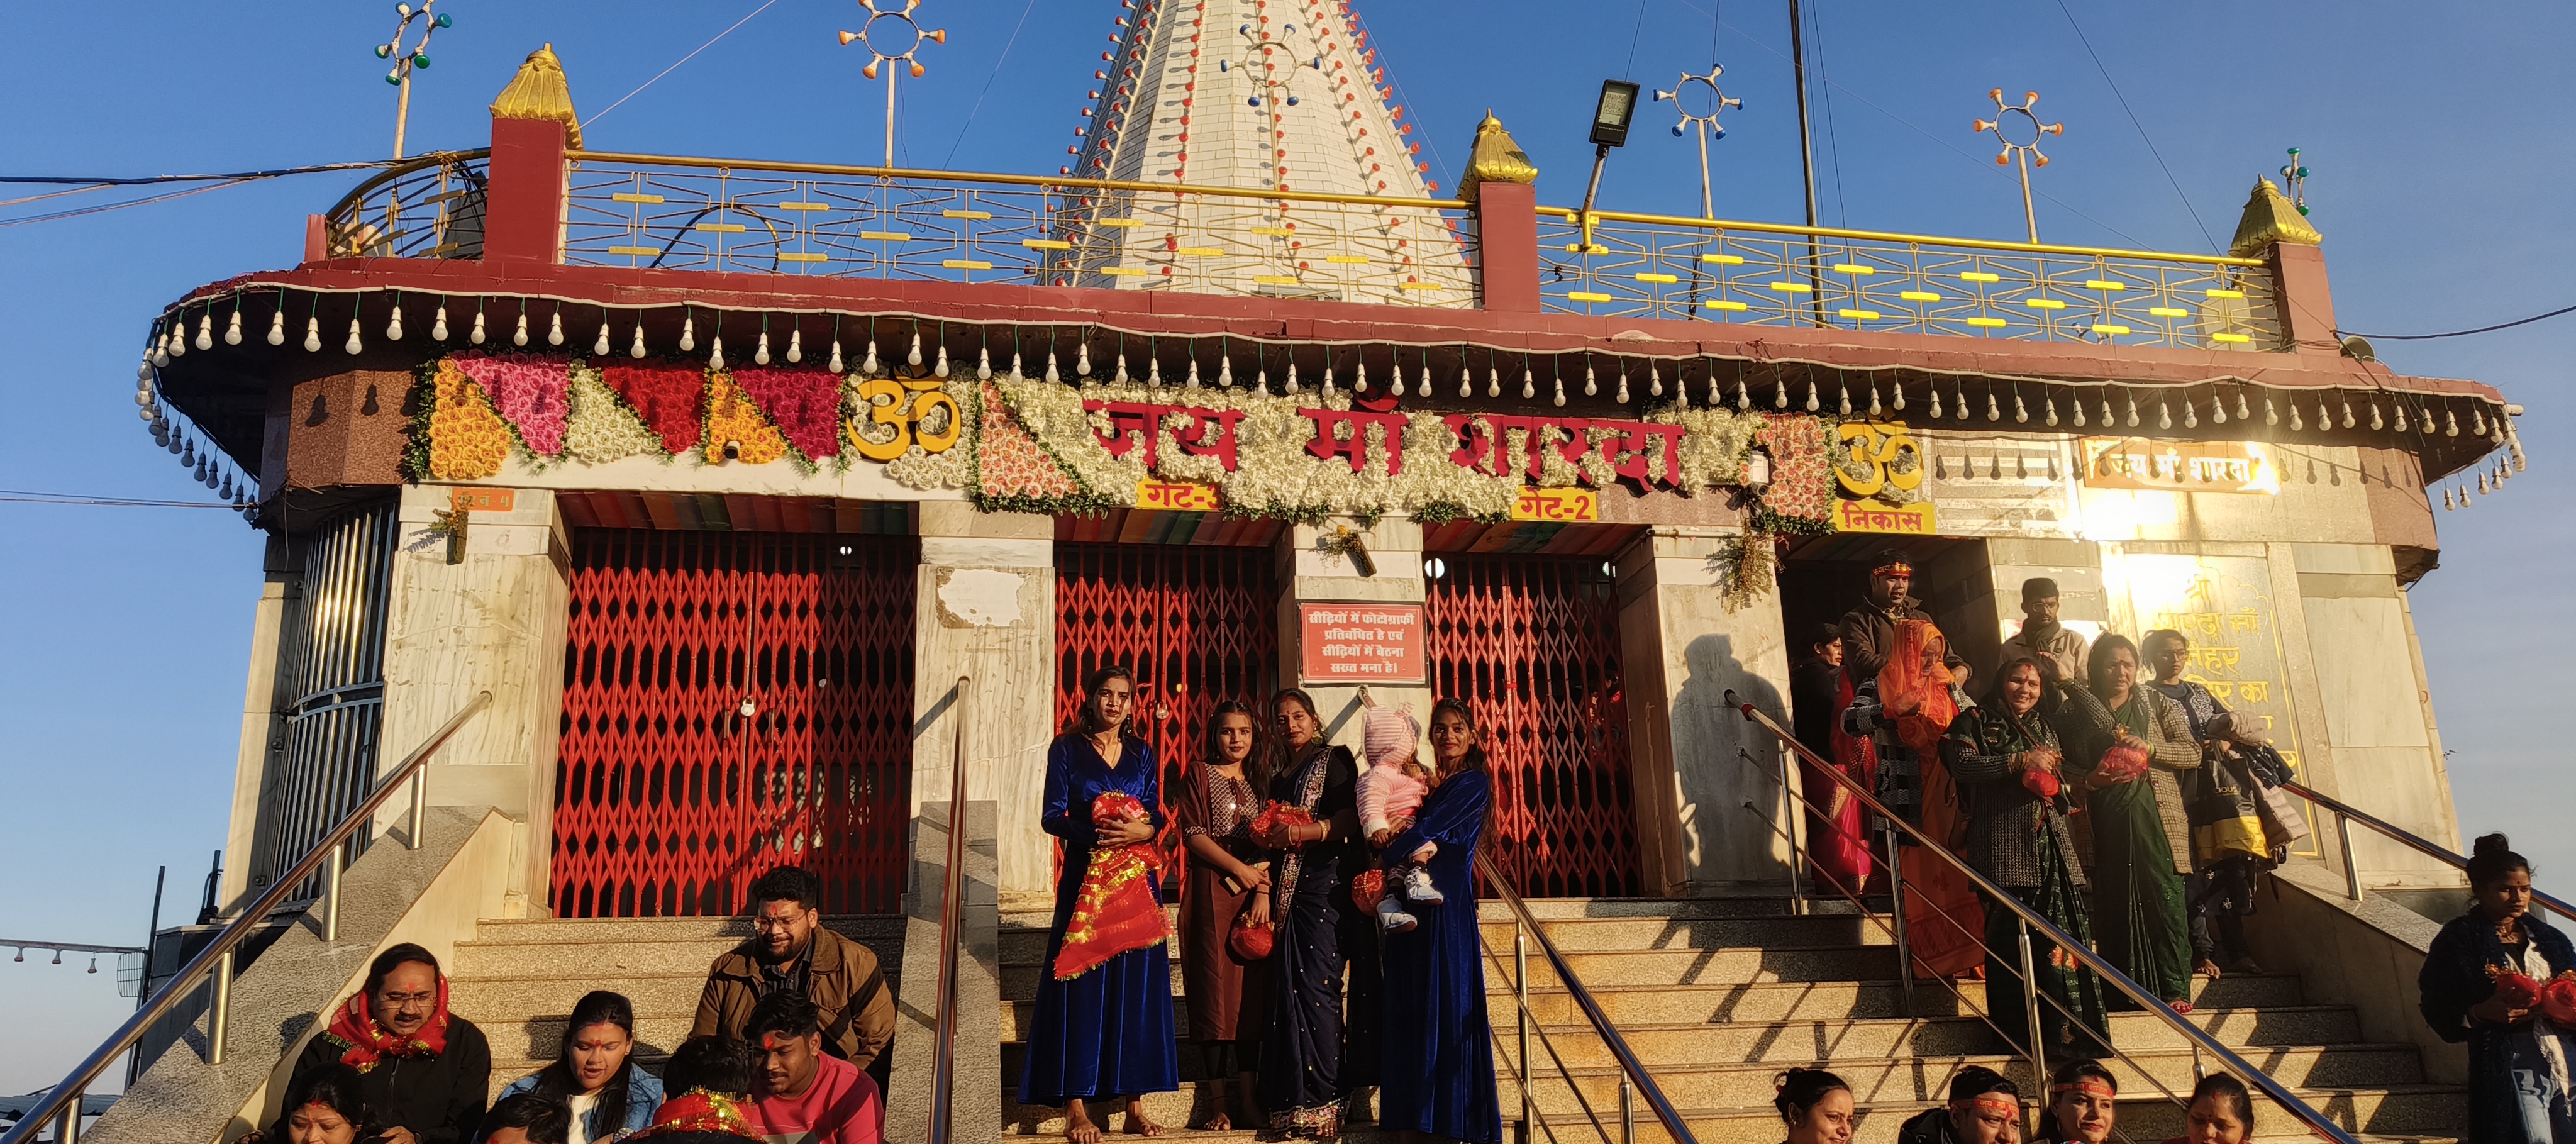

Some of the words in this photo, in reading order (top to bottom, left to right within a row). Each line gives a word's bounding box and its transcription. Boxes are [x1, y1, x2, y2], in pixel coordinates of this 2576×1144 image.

[1082, 399, 1246, 473] जय
[1442, 414, 1687, 492] शारदा
[2109, 453, 2147, 479] जय
[2189, 455, 2251, 482] शारदा
[1519, 487, 1591, 520] गेट-2
[1840, 501, 1923, 531] निकास
[1308, 611, 1348, 626] सीढ़ियों
[1350, 611, 1361, 624] में
[1362, 612, 1414, 625] फोटोग्राफी
[1374, 628, 1385, 641] है
[1387, 628, 1405, 641] एवं
[1321, 644, 1362, 658] सीढ़ियों
[1363, 644, 1375, 657] में
[1330, 663, 1358, 673] सख्त
[1360, 663, 1382, 673] मना
[2238, 681, 2270, 709] का
